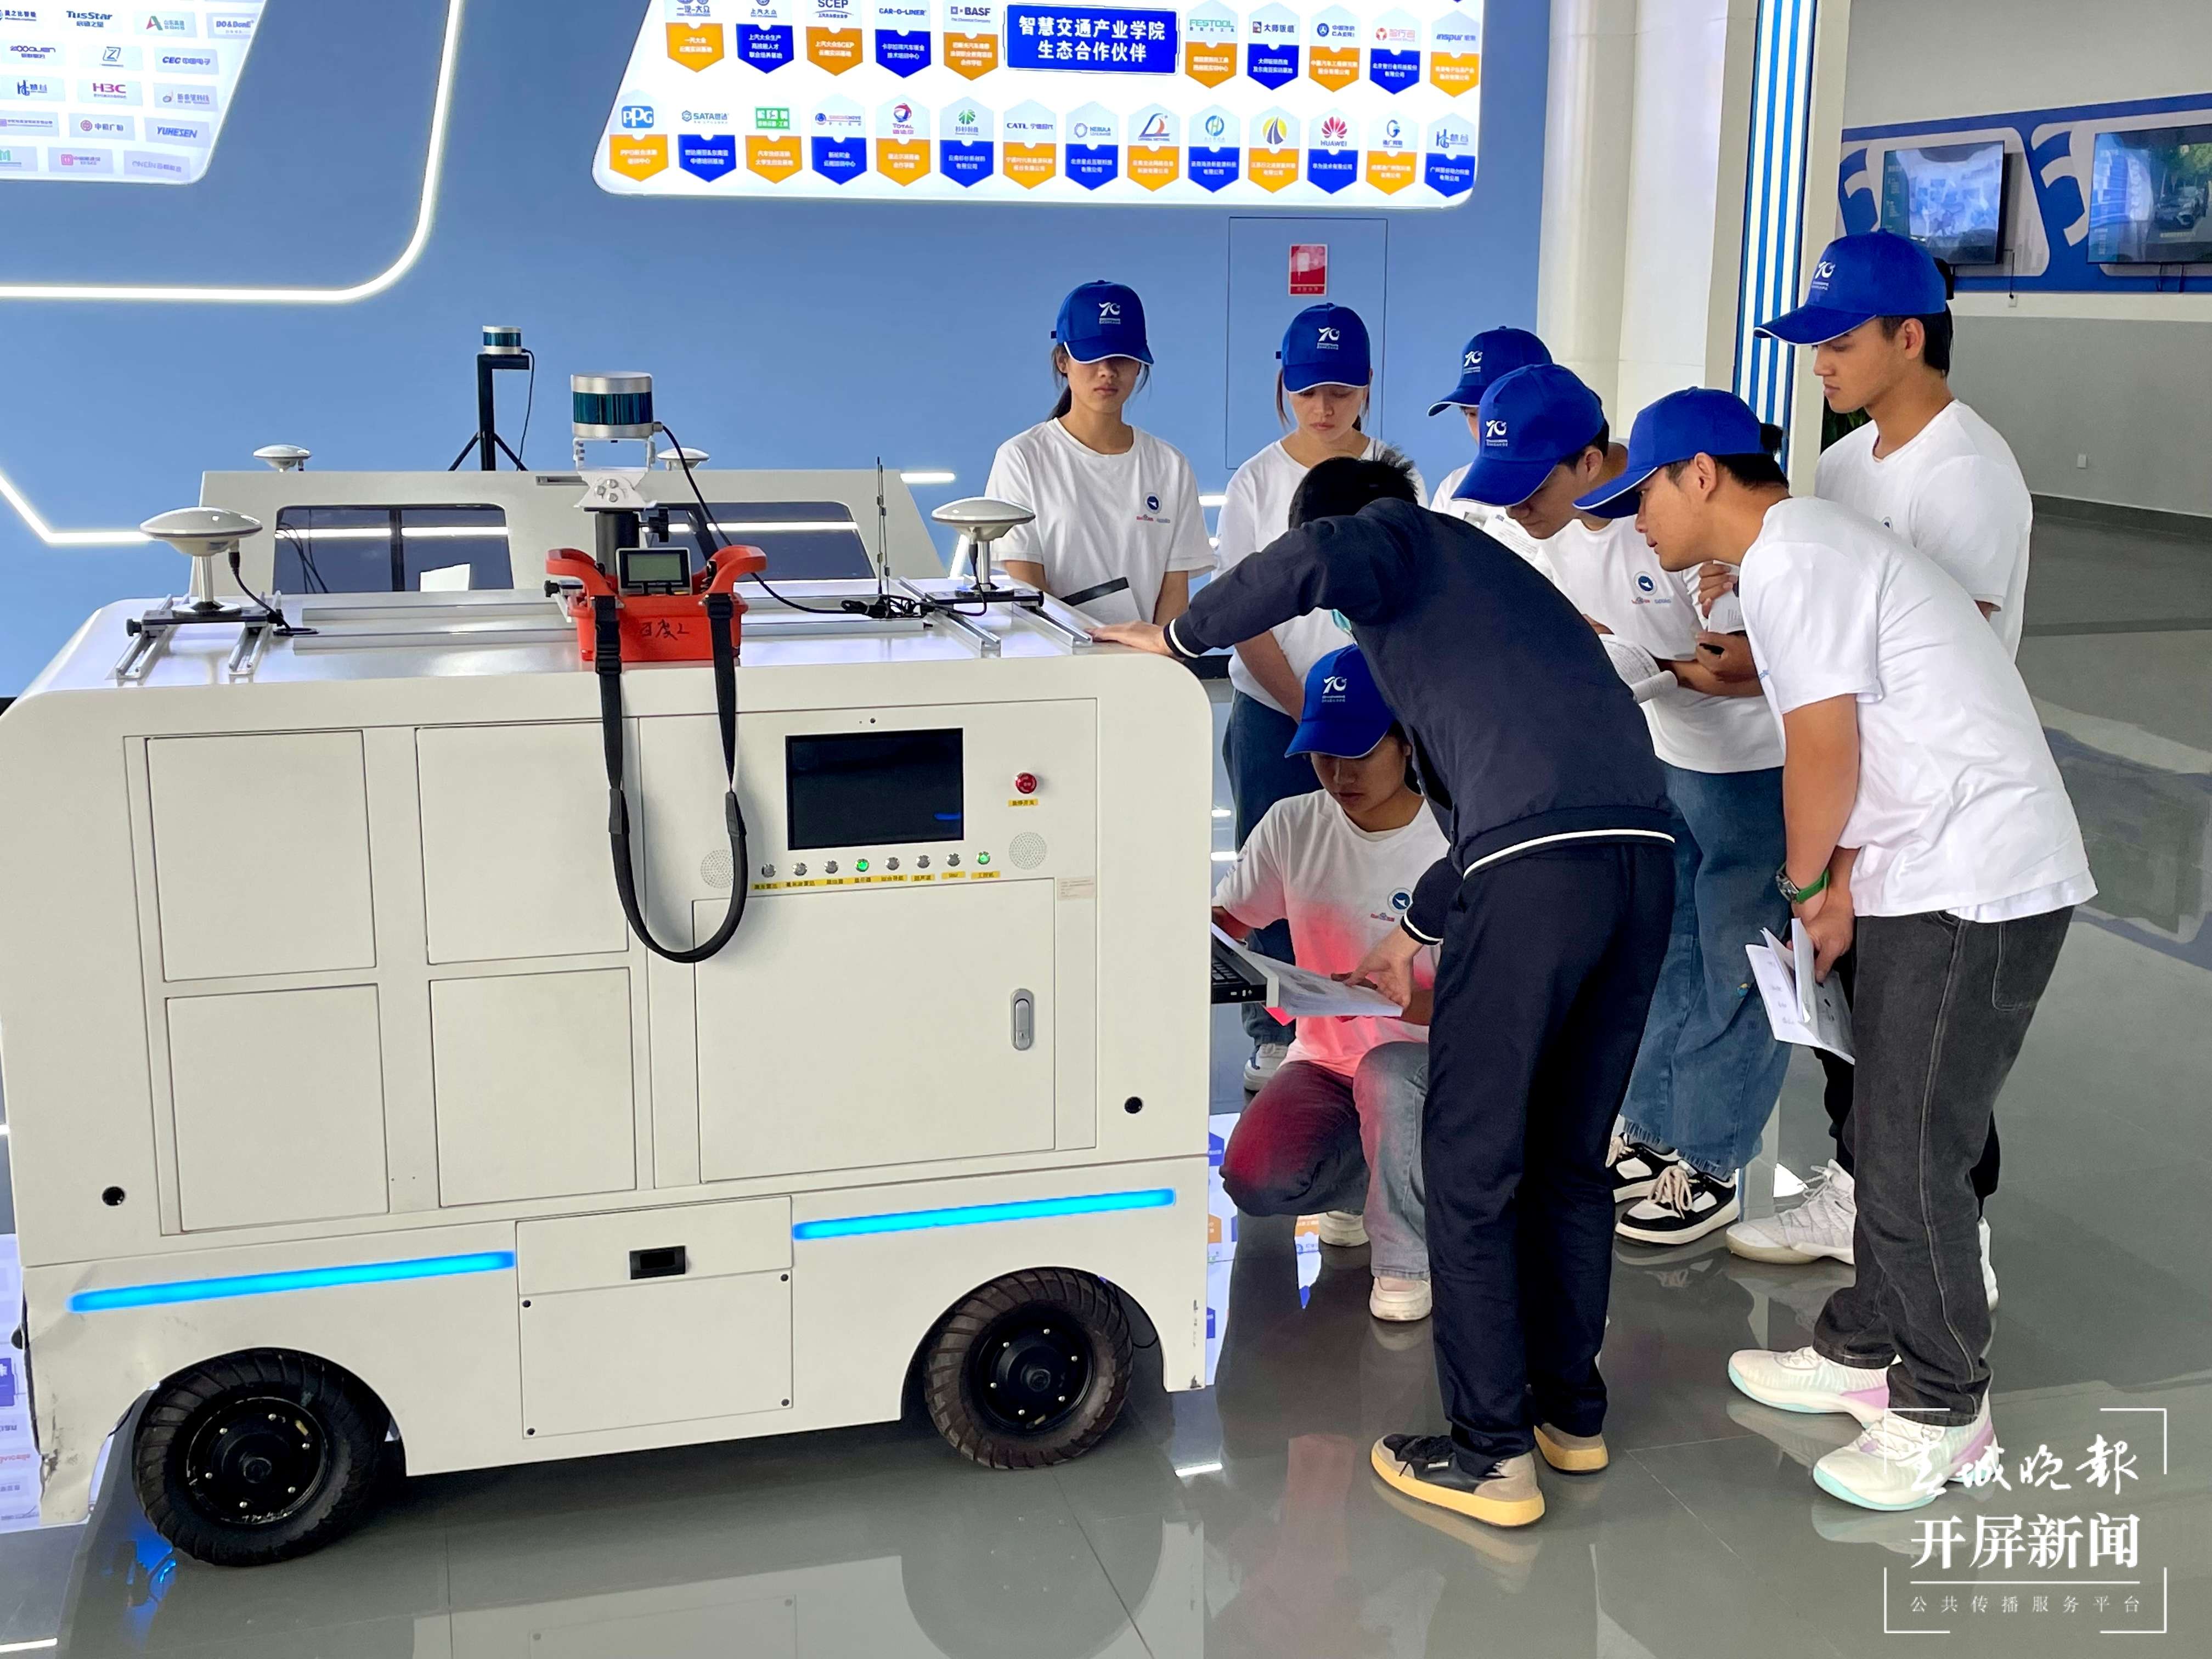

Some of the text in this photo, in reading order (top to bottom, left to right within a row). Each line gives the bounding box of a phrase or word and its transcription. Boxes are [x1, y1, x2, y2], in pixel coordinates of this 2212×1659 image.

[817, 0, 849, 8] SCEP
[66, 10, 113, 20] TusStar
[964, 7, 991, 16] BASF
[1019, 15, 1165, 41] 智慧交通产业学院
[1189, 19, 1234, 27] FESTOOL
[1436, 33, 1463, 42] inspur
[1037, 40, 1147, 63] 生态合作伙伴
[92, 83, 127, 94] H3C
[623, 108, 653, 127] PPG
